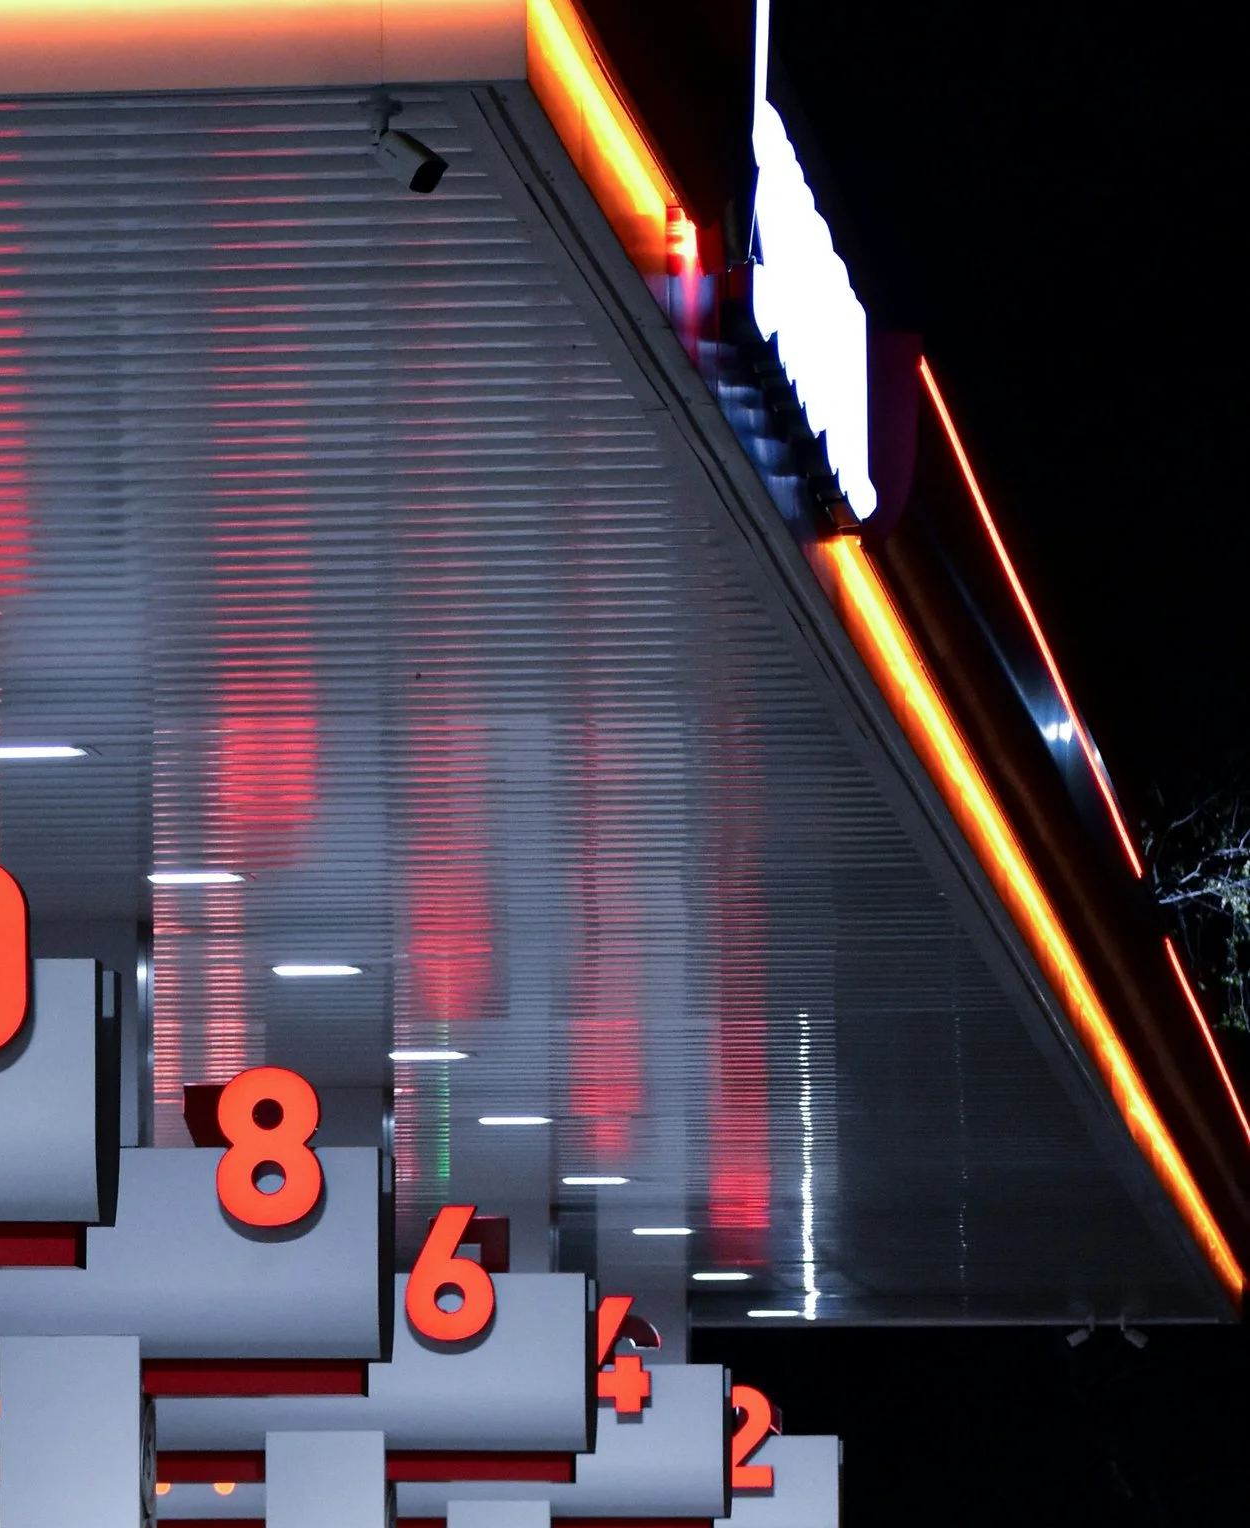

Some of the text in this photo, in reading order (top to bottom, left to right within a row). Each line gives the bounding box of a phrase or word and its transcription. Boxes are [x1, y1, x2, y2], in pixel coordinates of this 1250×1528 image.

[216, 1065, 322, 1227] 8
[405, 1204, 496, 1341] 6
[598, 1296, 651, 1413] 4
[732, 1385, 774, 1488] 2
